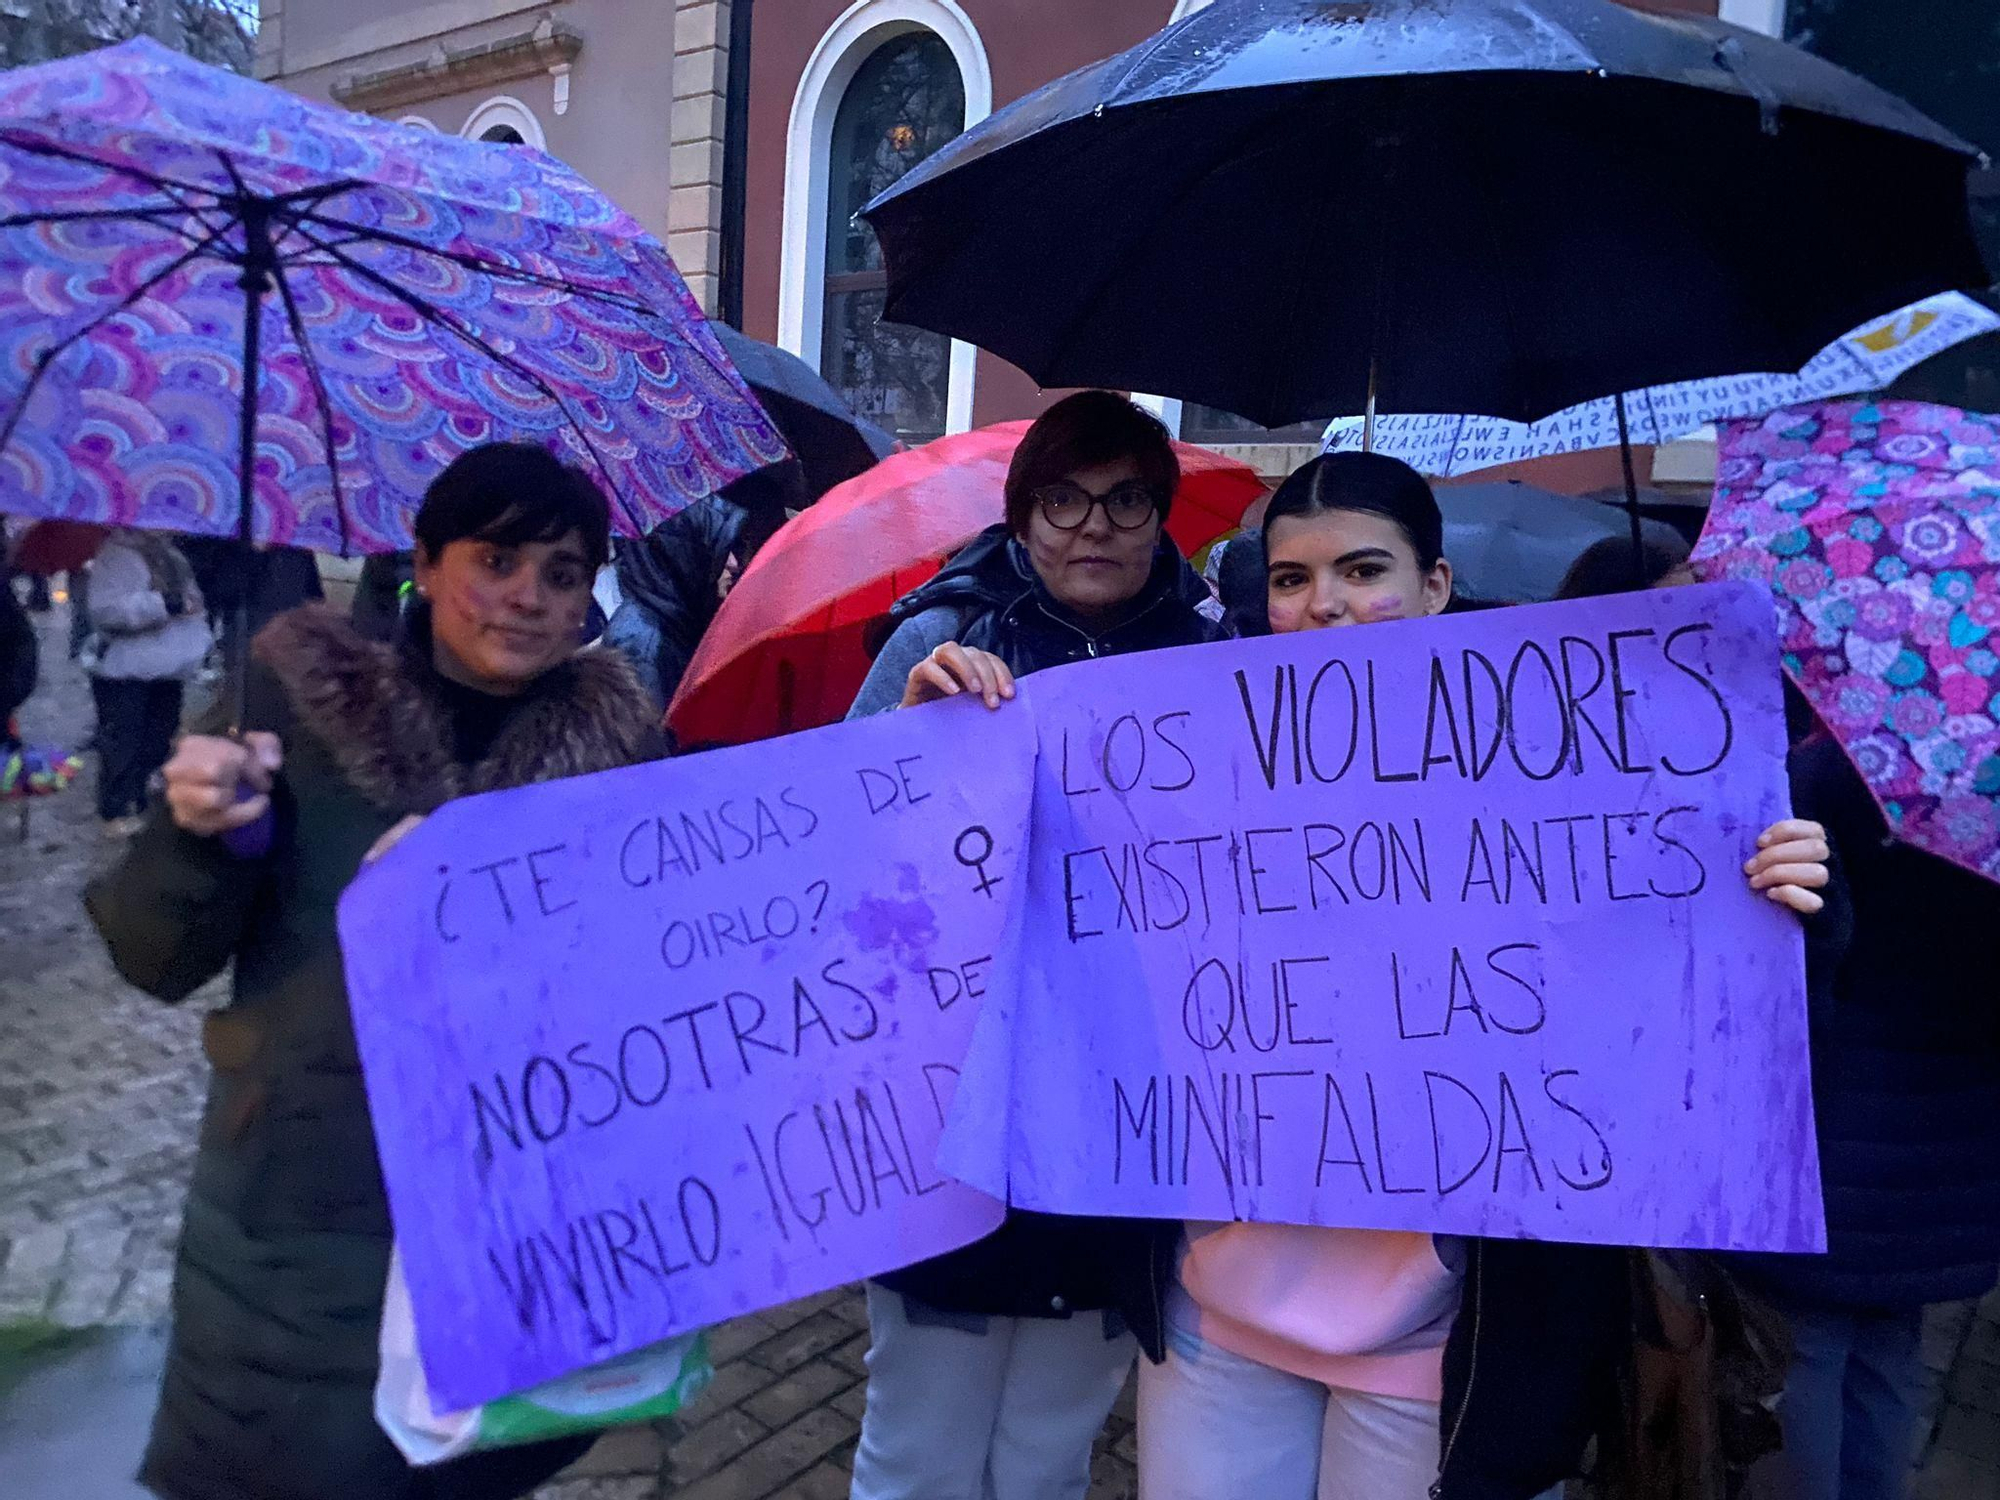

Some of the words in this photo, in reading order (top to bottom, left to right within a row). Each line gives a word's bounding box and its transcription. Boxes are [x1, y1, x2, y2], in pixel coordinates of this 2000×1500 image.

[1060, 710, 1195, 797] LOS
[1234, 622, 1734, 791] VIOLADORES
[619, 787, 819, 887] CANSAS
[856, 755, 932, 814] DE
[1062, 816, 1432, 944] EXISTIERON
[1460, 805, 1707, 905] ANTES
[661, 880, 830, 969] OIRLO?
[468, 958, 879, 1163] NOSOTRAS
[928, 955, 993, 1011] DE
[1181, 956, 1334, 1054] QUE
[1392, 942, 1547, 1040] LAS
[1112, 1069, 1613, 1195] MINIFALDAS
